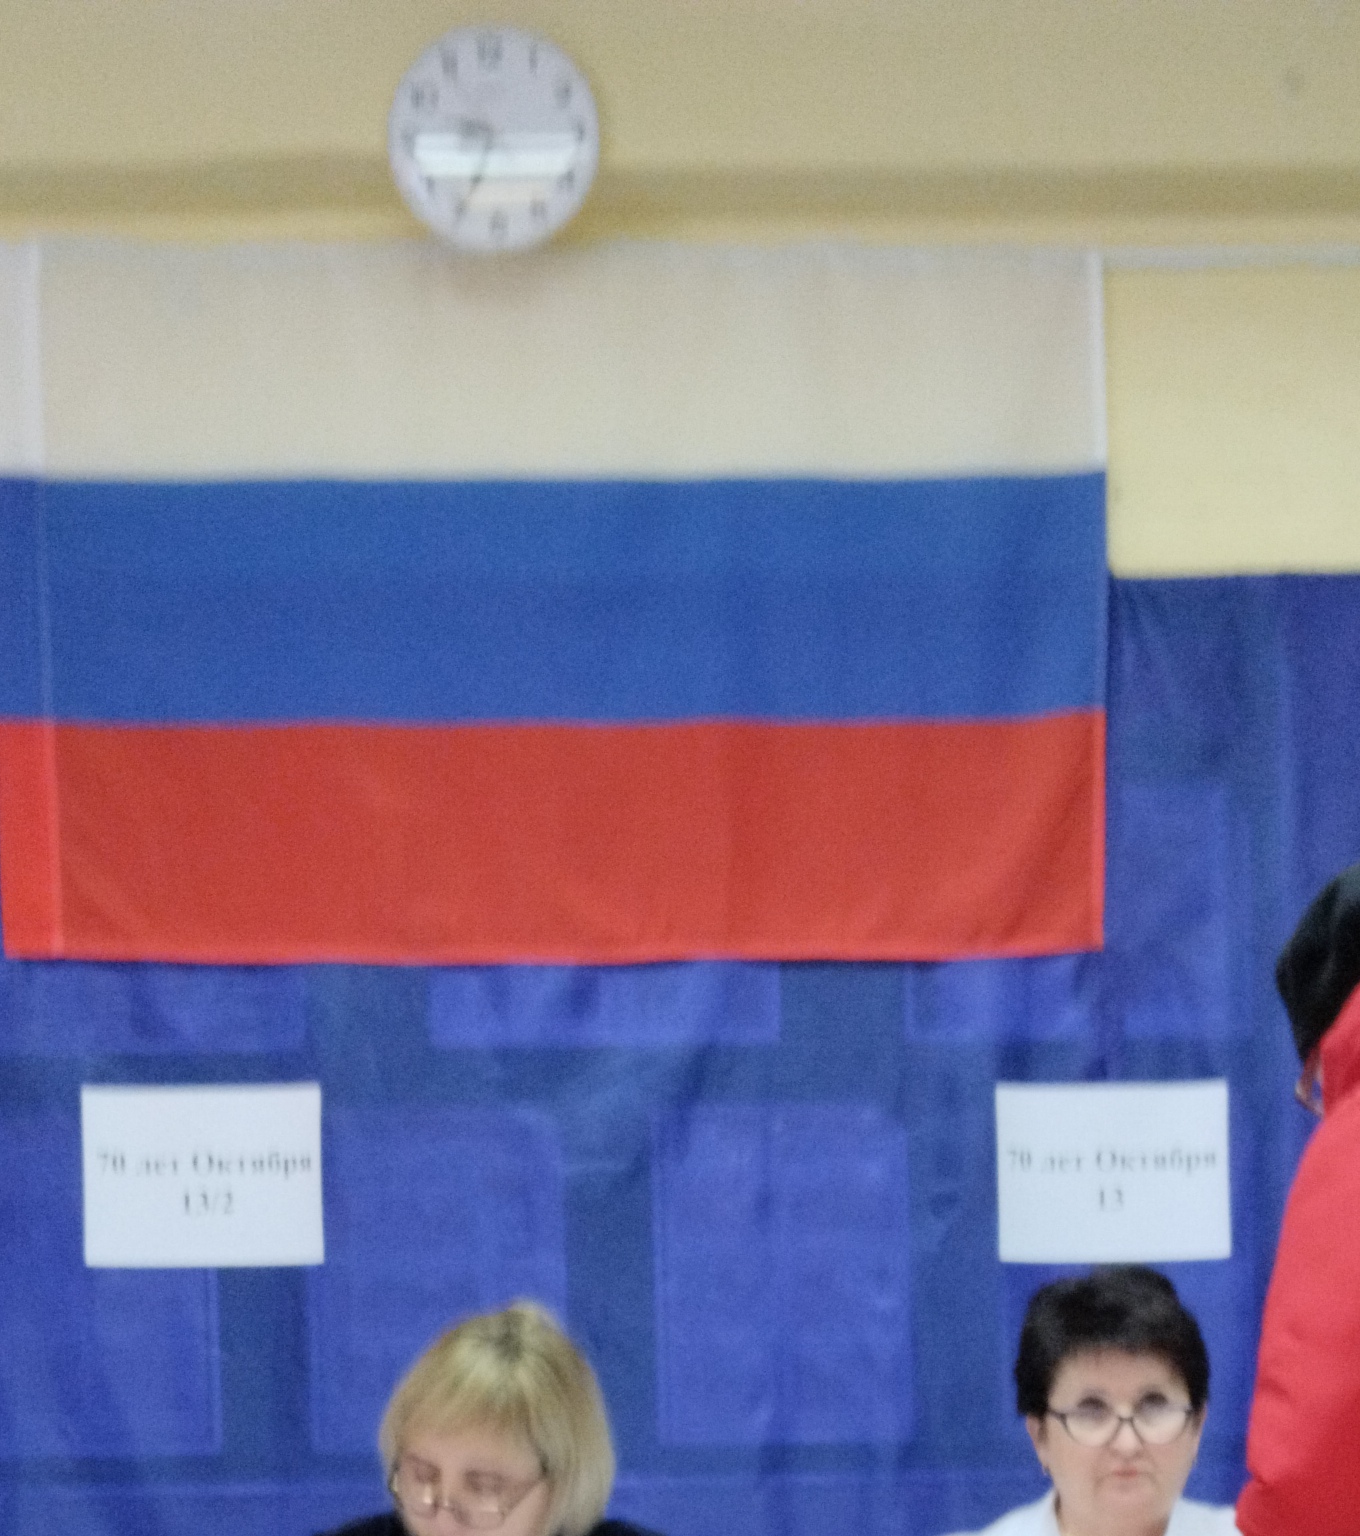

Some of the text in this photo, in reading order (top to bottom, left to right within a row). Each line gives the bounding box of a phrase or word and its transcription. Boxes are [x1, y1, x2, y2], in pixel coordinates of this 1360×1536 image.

[97, 1147, 126, 1176] 70
[191, 1147, 313, 1180] Октября
[1007, 1144, 1033, 1173] 70
[1095, 1145, 1218, 1175] Октября
